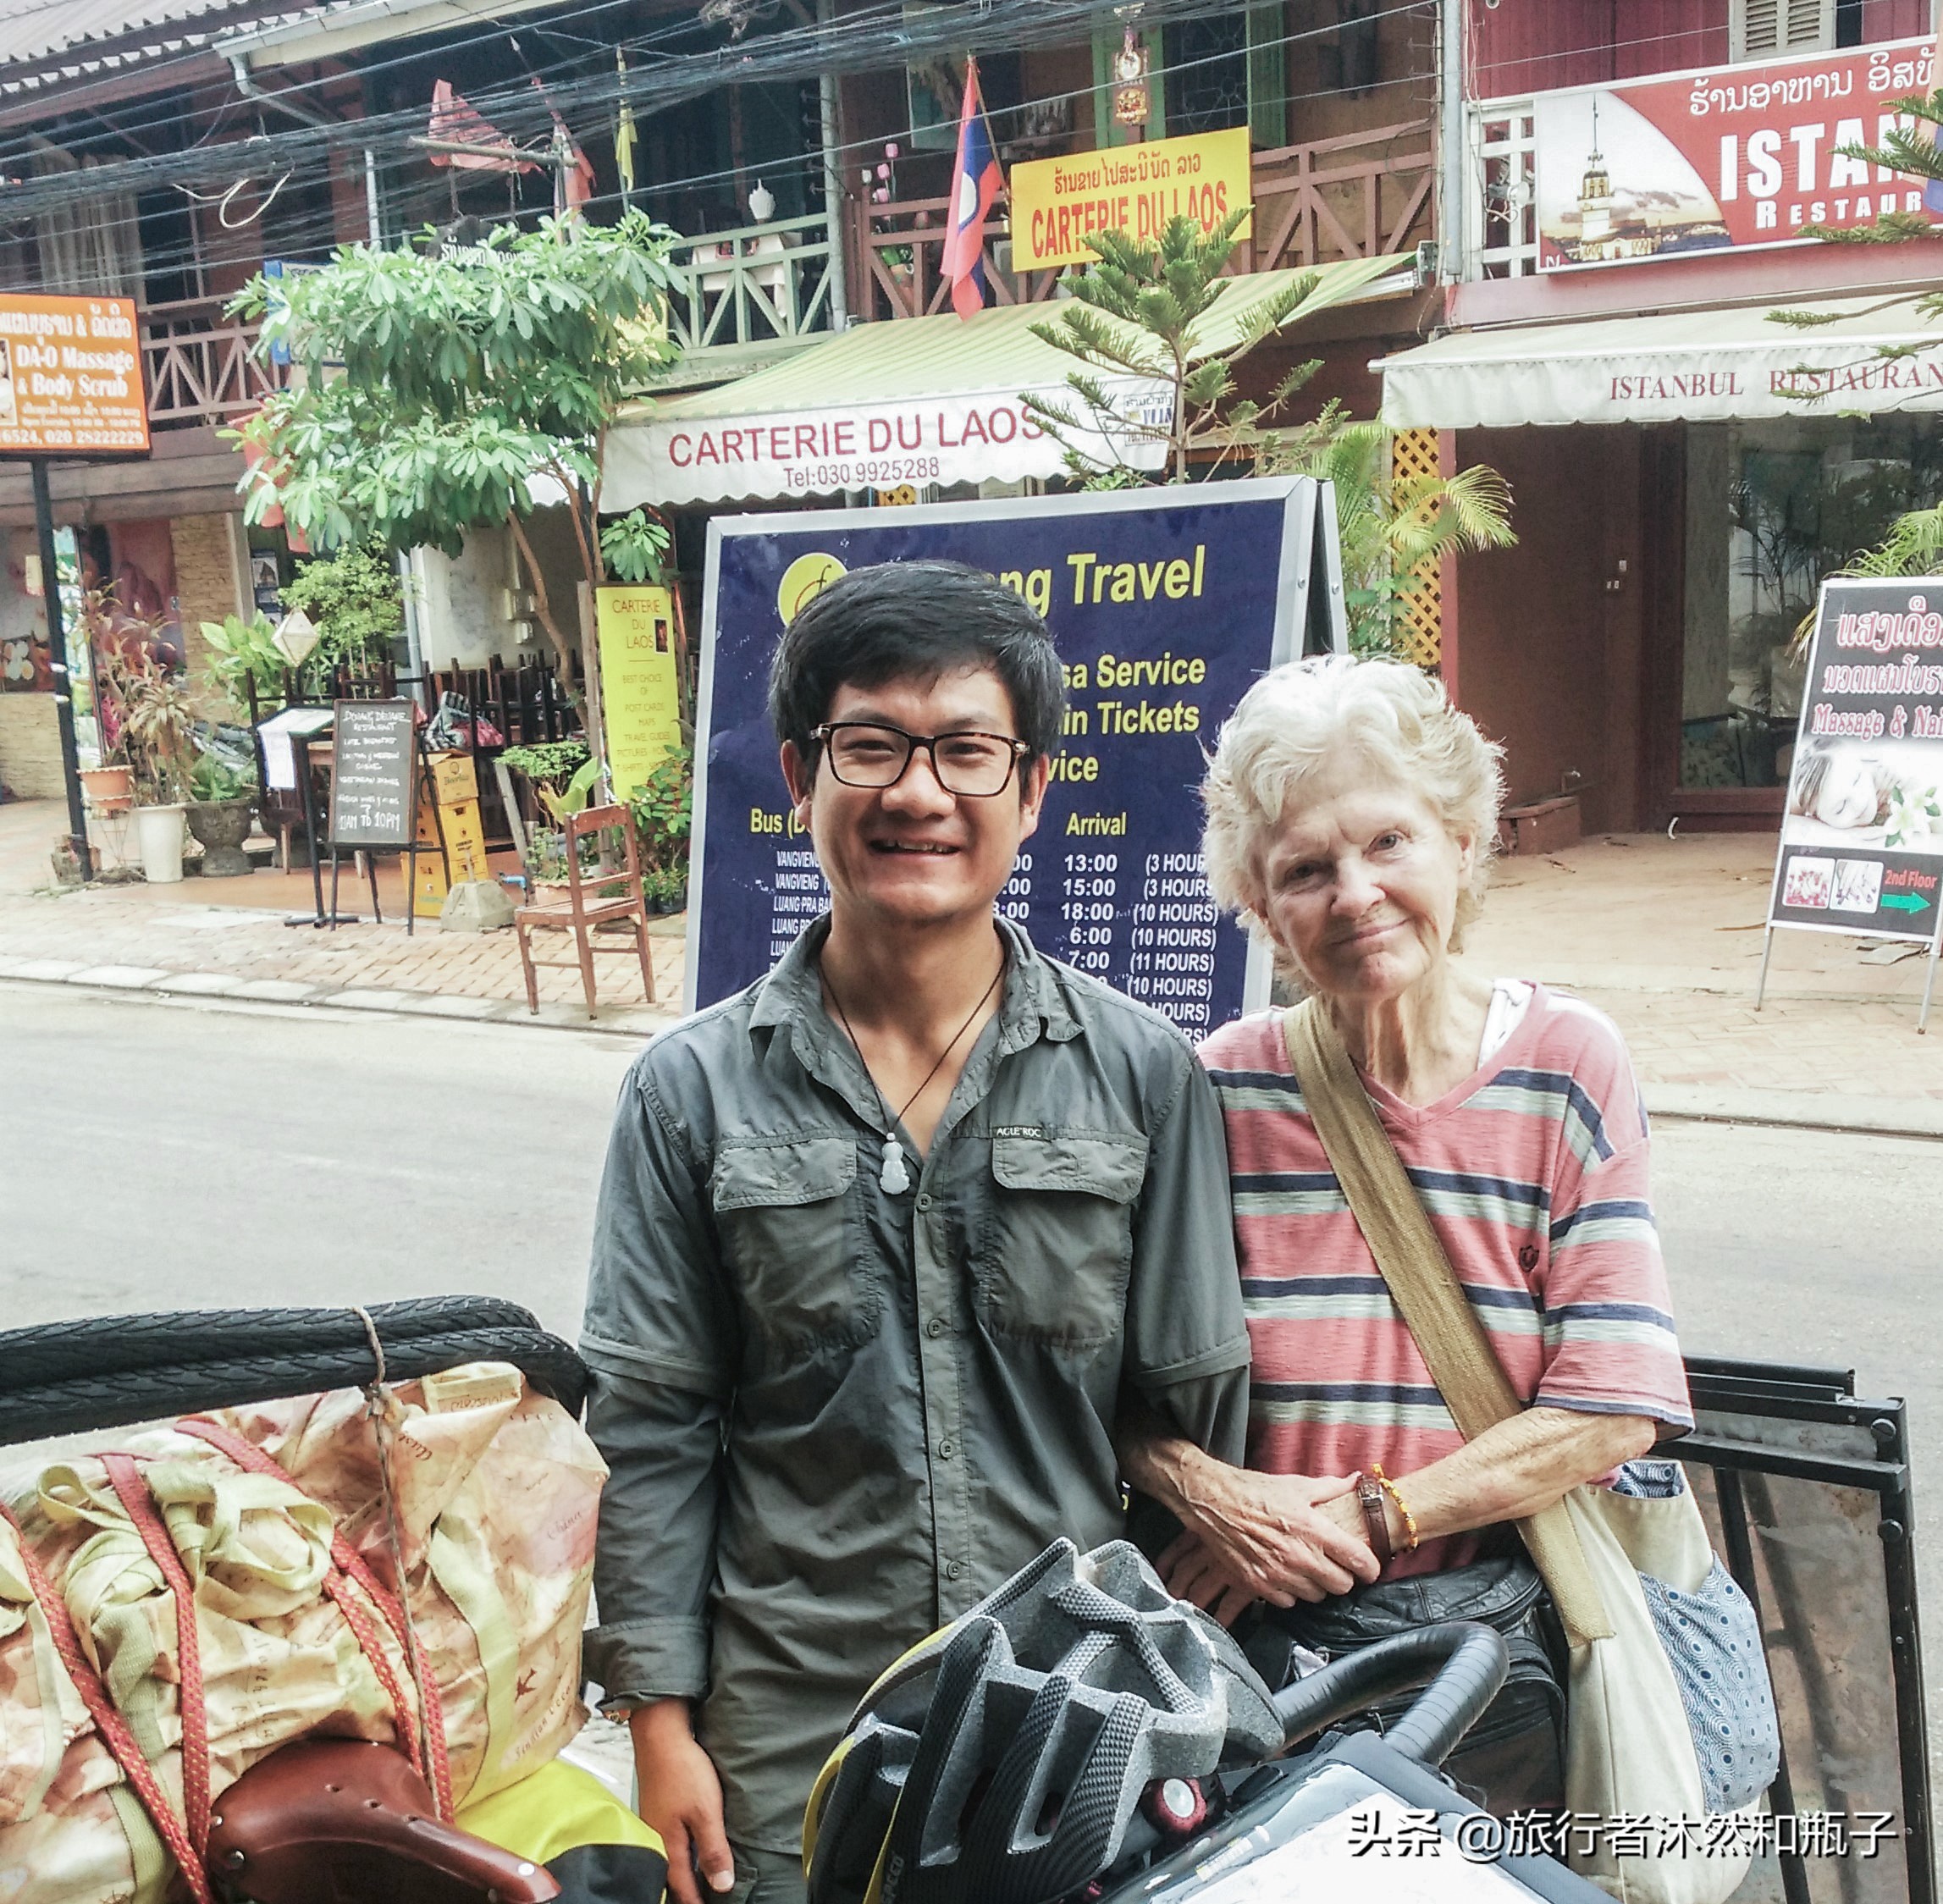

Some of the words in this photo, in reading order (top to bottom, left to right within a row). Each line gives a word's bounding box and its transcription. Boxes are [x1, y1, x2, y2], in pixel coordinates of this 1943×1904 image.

[1137, 190, 1164, 244] DU
[62, 346, 135, 375] Massage
[32, 373, 75, 400] Body
[79, 373, 128, 397] Scrub
[1611, 372, 1744, 400] ISTANBUL
[669, 421, 857, 467] CARTERIE
[869, 414, 922, 453] DU
[938, 405, 1045, 447] LAOS
[783, 463, 850, 488] Tel:030
[856, 457, 940, 483] 9925288
[1067, 544, 1206, 605] Travel
[627, 635, 654, 648] LAOS
[1096, 651, 1206, 688] Service
[1096, 700, 1201, 735] Tickets
[1812, 704, 1885, 742] Massage
[1890, 704, 1907, 739] &
[750, 808, 783, 833] Bus
[1065, 812, 1127, 836] Arrival
[1064, 854, 1118, 872] 13:00
[1063, 878, 1116, 897] 15:00
[1885, 869, 1907, 886] 2nd
[1907, 870, 1939, 889] Floor
[773, 895, 800, 913] LUANG
[1061, 902, 1114, 921] 18:00
[1133, 903, 1156, 926] (10
[1159, 903, 1219, 927] HOURS)
[771, 917, 798, 935] LUANG
[1069, 927, 1112, 946] 6:00
[1131, 928, 1154, 950] (10
[1157, 928, 1217, 952] HOURS)
[1068, 950, 1110, 969] 7:00
[1129, 952, 1152, 975] (11
[1155, 952, 1215, 976] HOURS)
[1127, 976, 1149, 998] (10
[1152, 977, 1213, 1002] HOURS)
